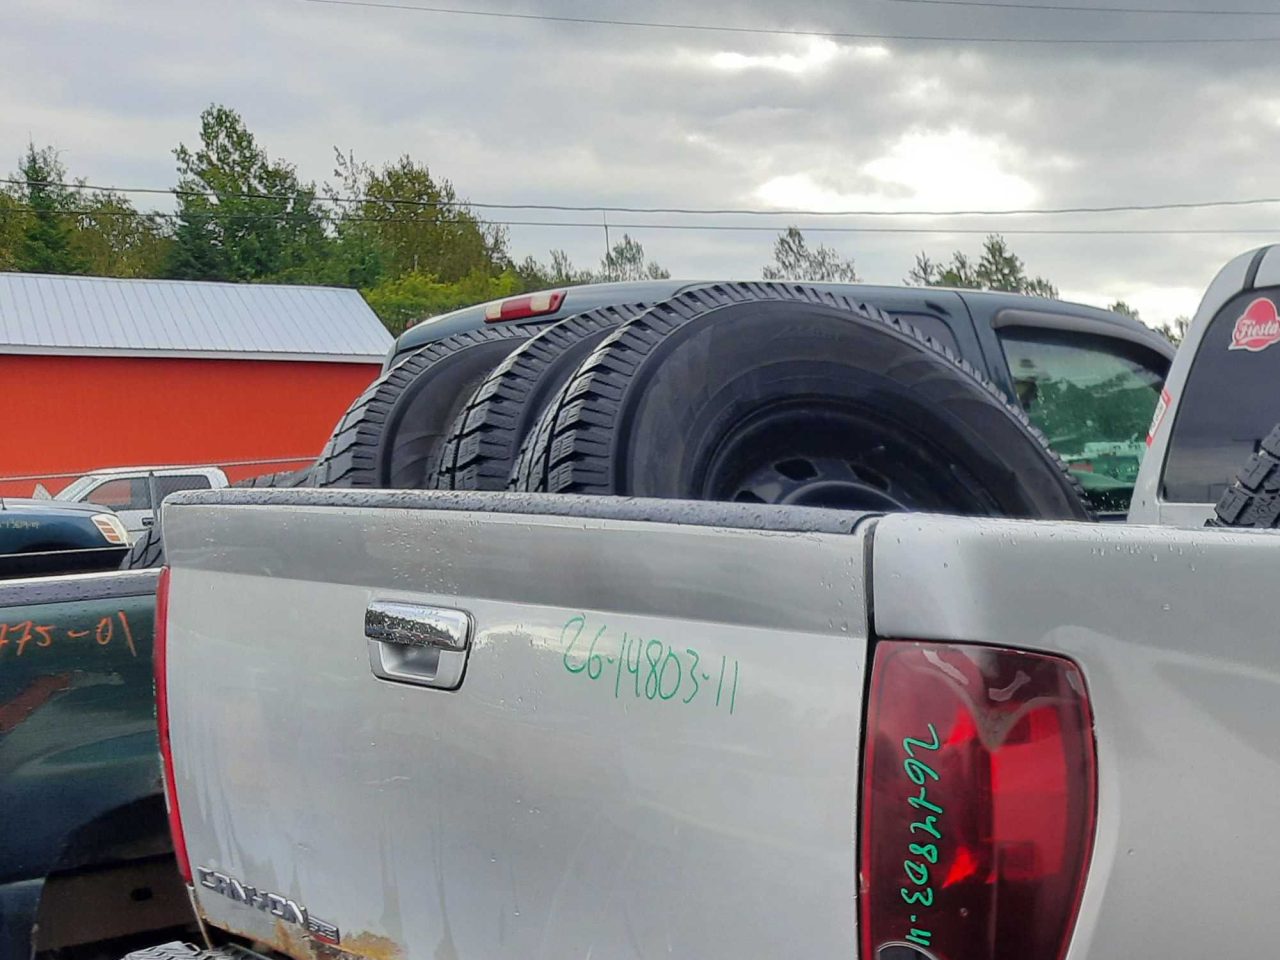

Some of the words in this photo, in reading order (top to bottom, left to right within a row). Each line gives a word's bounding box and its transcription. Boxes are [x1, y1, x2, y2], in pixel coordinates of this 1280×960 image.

[1235, 319, 1280, 340] Fiesta
[560, 613, 738, 714] 26-14803-11
[197, 865, 309, 931] CANYON
